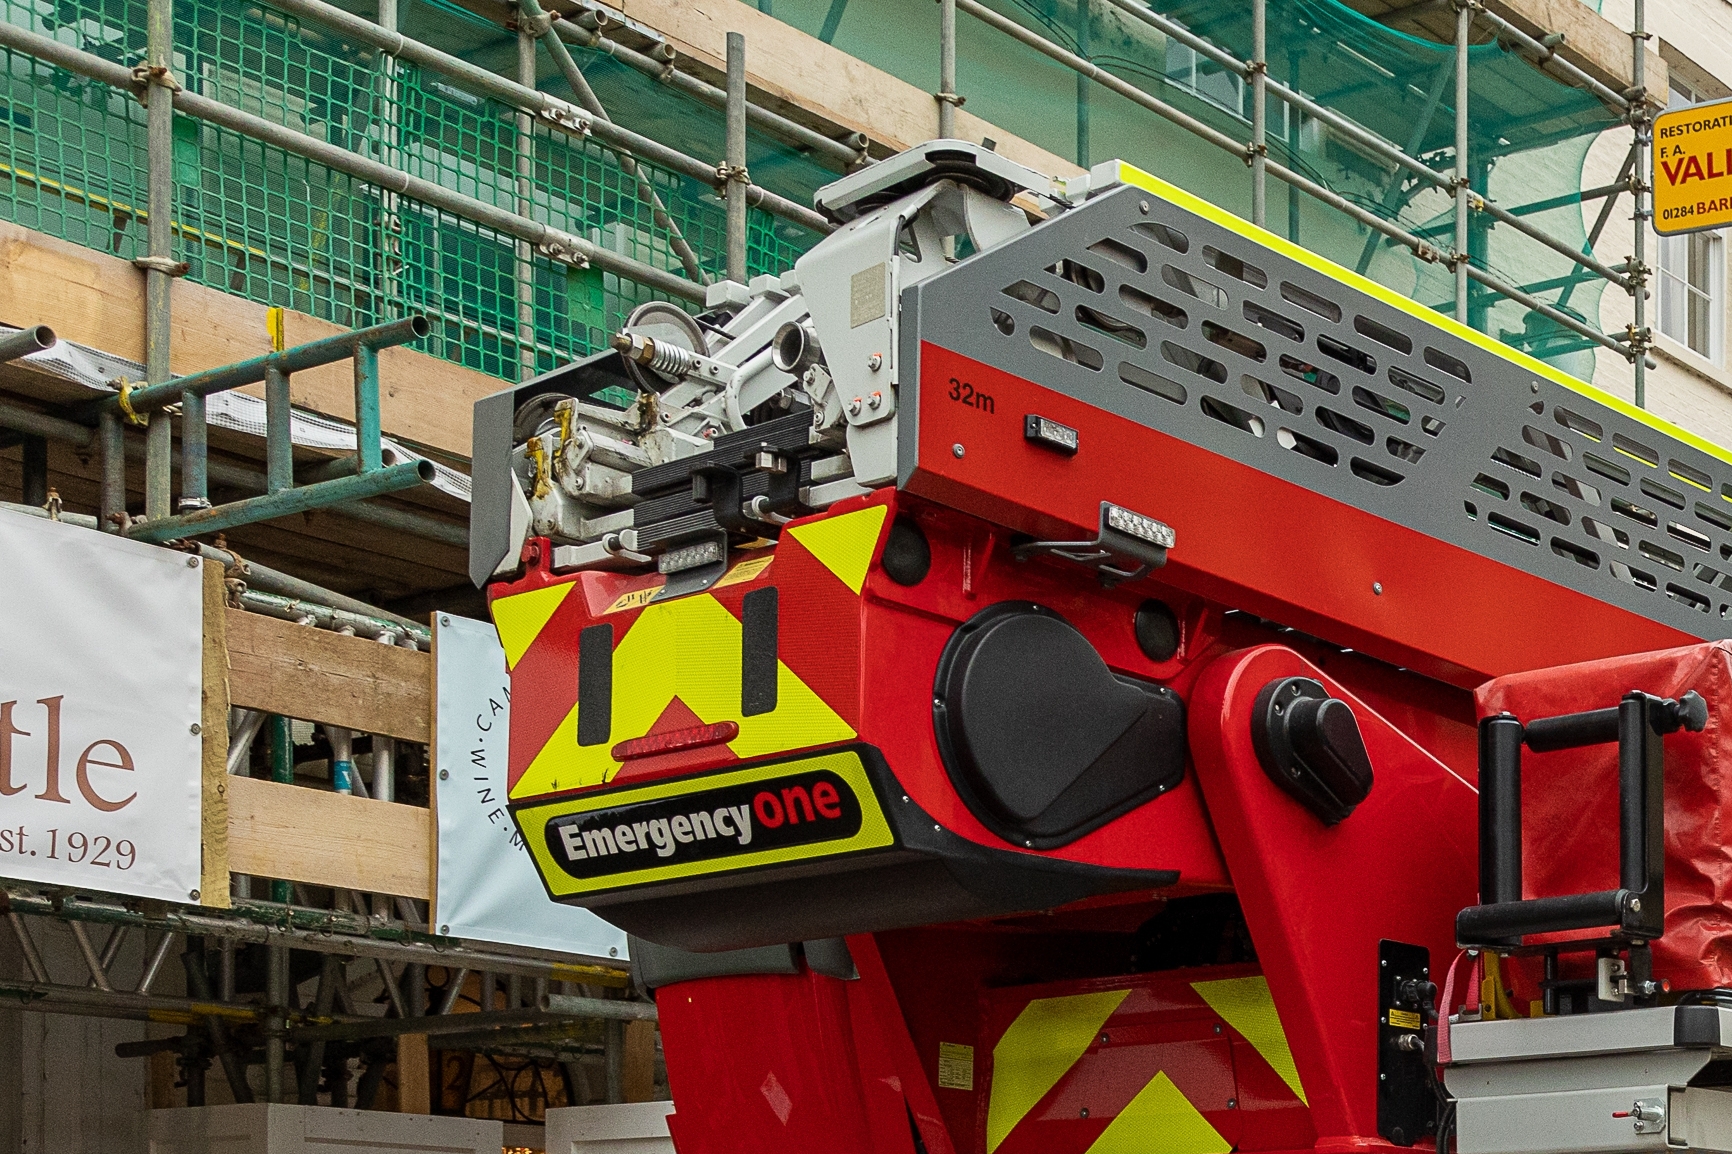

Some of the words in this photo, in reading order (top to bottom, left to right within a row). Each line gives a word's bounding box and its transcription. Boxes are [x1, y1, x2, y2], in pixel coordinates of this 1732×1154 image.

[1660, 147, 1668, 158] F.
[1672, 144, 1686, 156] A.
[1662, 205, 1694, 220] 01284
[948, 378, 995, 415] 32m
[471, 749, 505, 824] WINE
